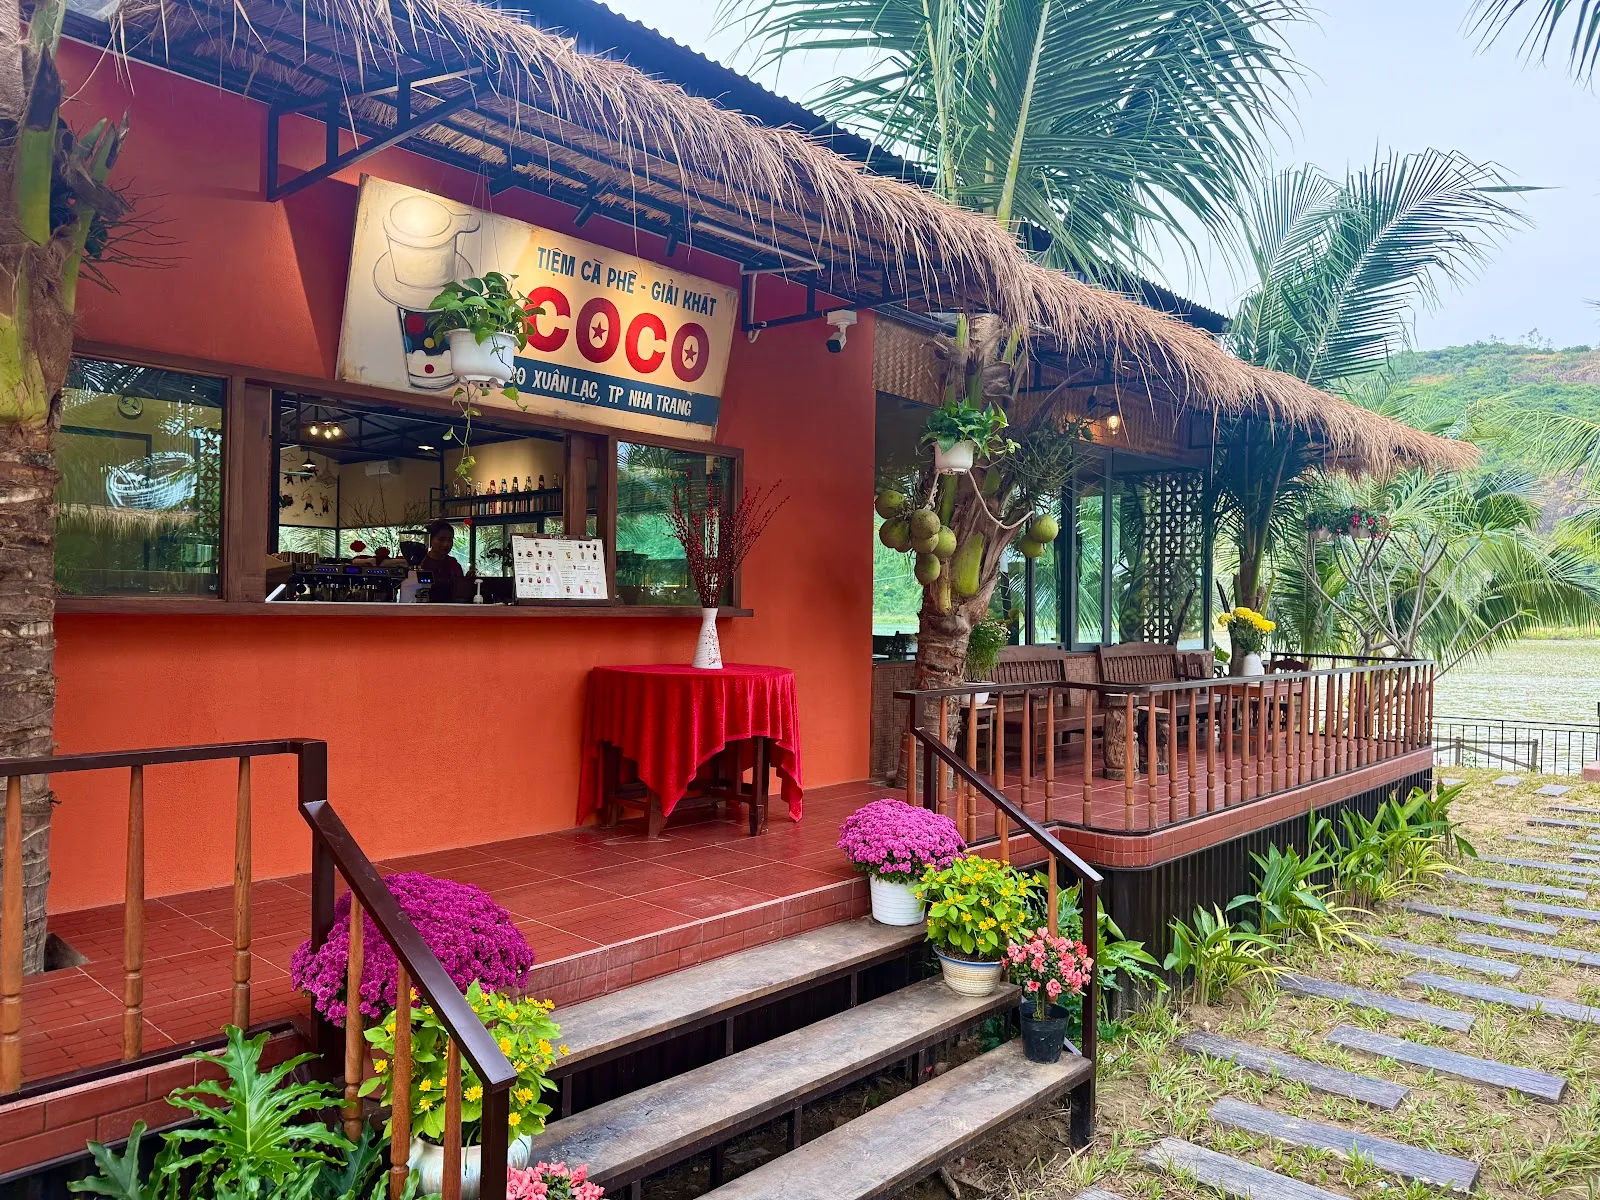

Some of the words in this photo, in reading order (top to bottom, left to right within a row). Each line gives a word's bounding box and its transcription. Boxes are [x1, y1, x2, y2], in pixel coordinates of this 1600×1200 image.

[538, 247, 576, 277] TIỆM
[581, 258, 603, 286] CÀ
[607, 268, 638, 294] PHÊ
[651, 279, 679, 306] GIẢI
[682, 293, 717, 317] KHÁT
[523, 286, 710, 383] COCO
[532, 369, 568, 394] XUÂN
[572, 380, 601, 403] LẠC,
[608, 385, 624, 404] TP
[628, 389, 652, 410] NHA
[656, 394, 692, 416] TRANG
